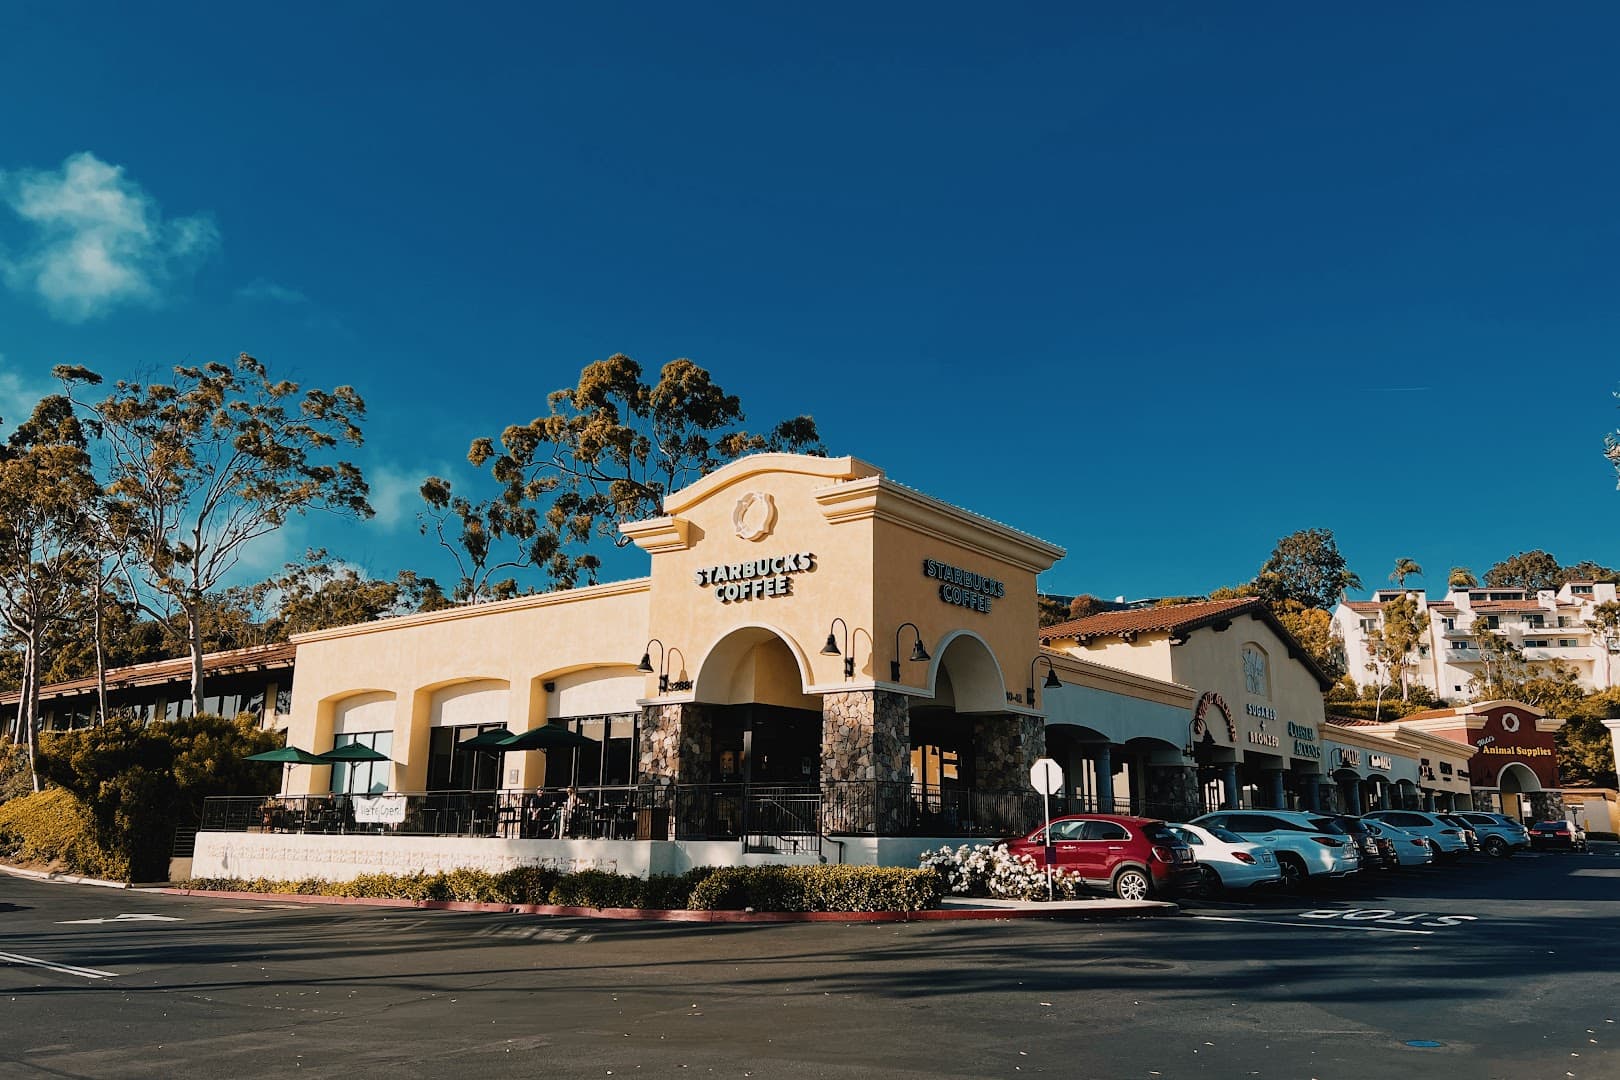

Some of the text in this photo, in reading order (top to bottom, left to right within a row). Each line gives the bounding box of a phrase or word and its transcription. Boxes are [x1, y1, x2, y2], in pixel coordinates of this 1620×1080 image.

[695, 552, 814, 586] STARBUCKS
[925, 558, 1004, 598] STARBUCKS
[714, 574, 791, 602] COFFEE
[941, 584, 992, 613] COFFEE
[1246, 703, 1277, 720] SUGARED
[1249, 731, 1280, 747] BRONZED
[1483, 745, 1552, 757] Animal Supplies
[1298, 908, 1479, 928] STOP
